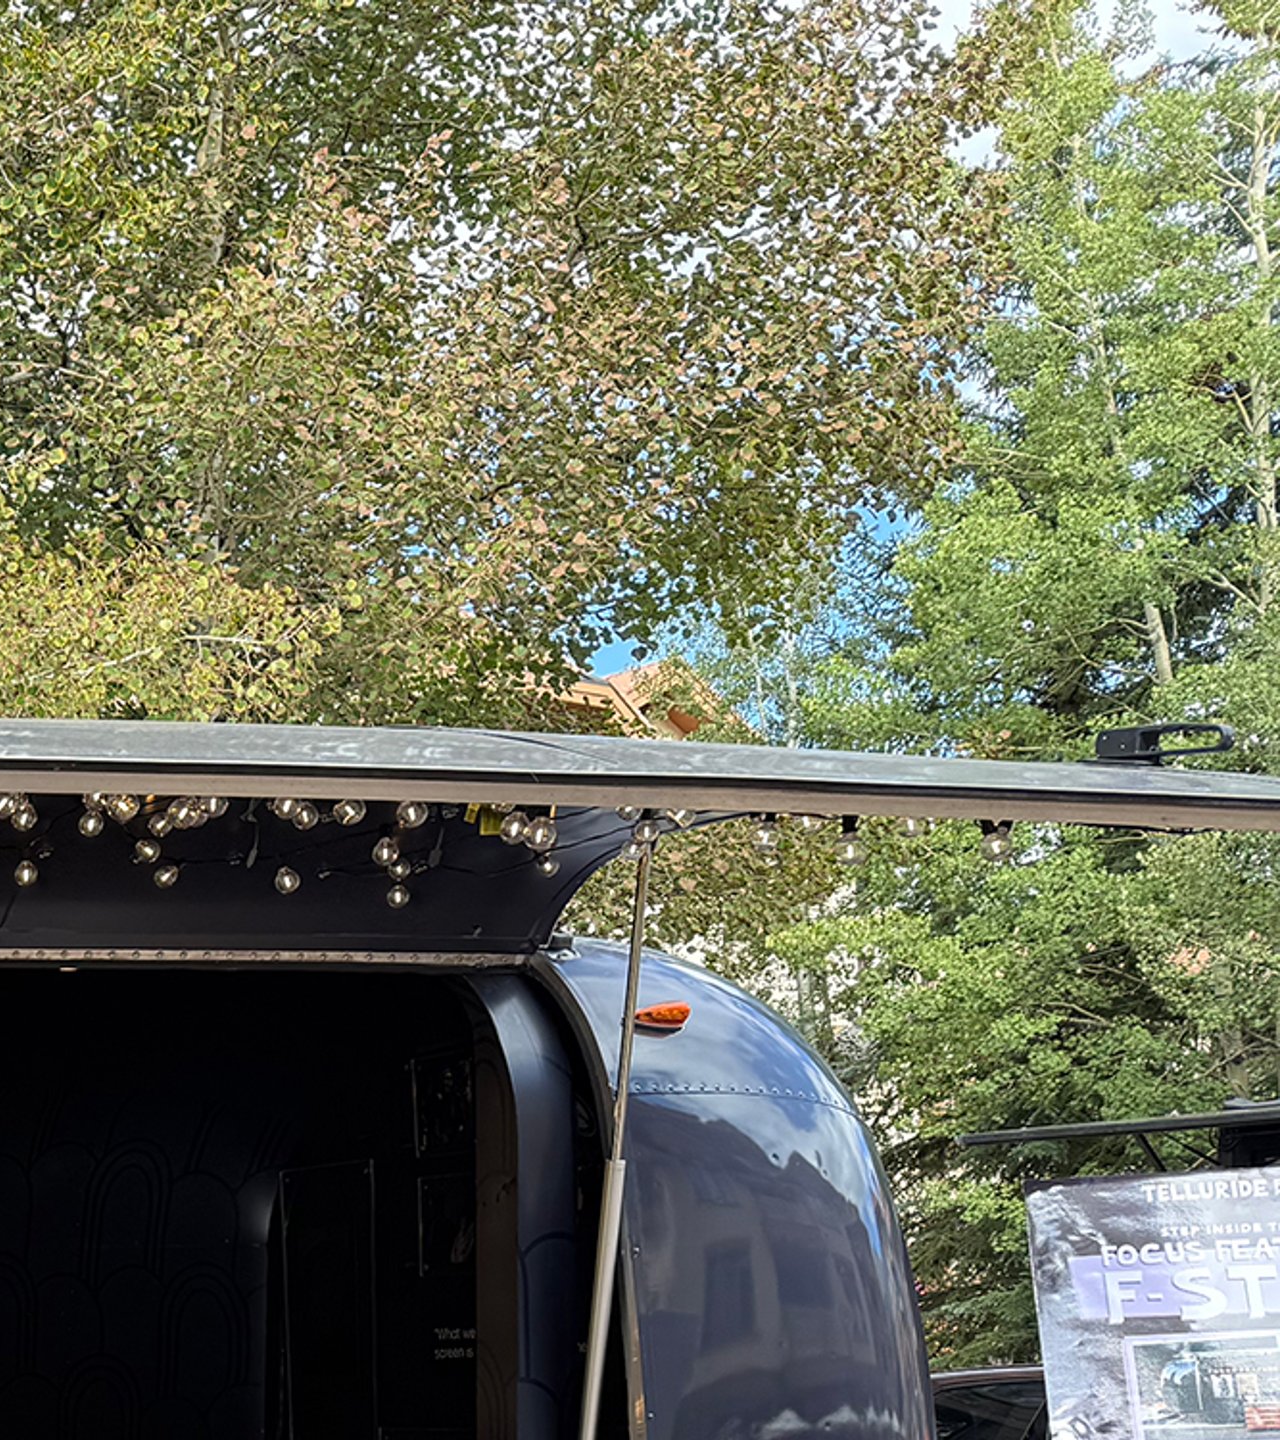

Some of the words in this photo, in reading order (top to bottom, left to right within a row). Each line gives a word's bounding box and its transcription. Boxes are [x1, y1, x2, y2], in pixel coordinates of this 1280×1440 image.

[1141, 1179, 1269, 1202] TELLURIDE
[1207, 1222, 1262, 1235] INSIDE
[1101, 1241, 1205, 1267] FOCUS
